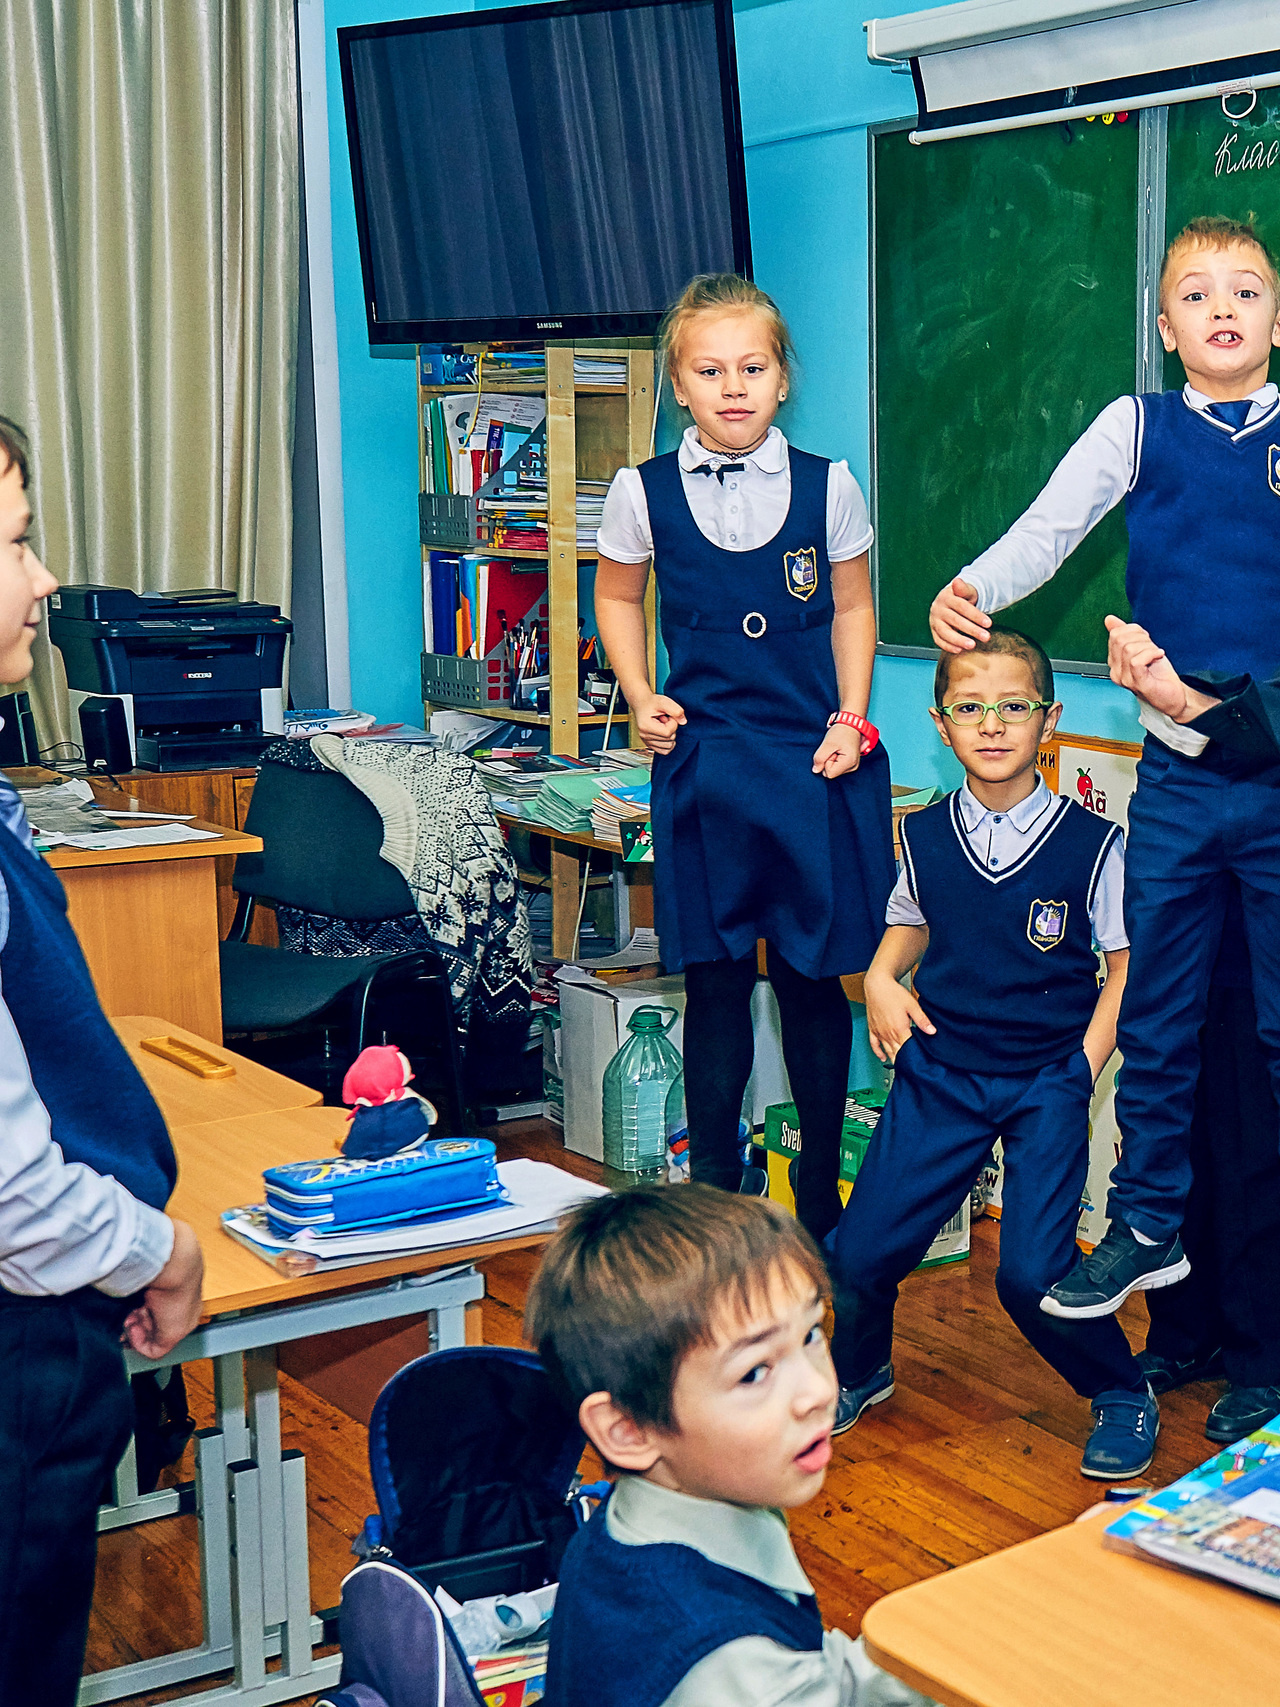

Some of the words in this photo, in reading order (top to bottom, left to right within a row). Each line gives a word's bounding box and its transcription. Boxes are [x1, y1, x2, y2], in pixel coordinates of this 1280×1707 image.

[536, 321, 563, 329] SAMSUNG
[1082, 789, 1107, 814] Aa
[781, 1121, 802, 1152] Svet
